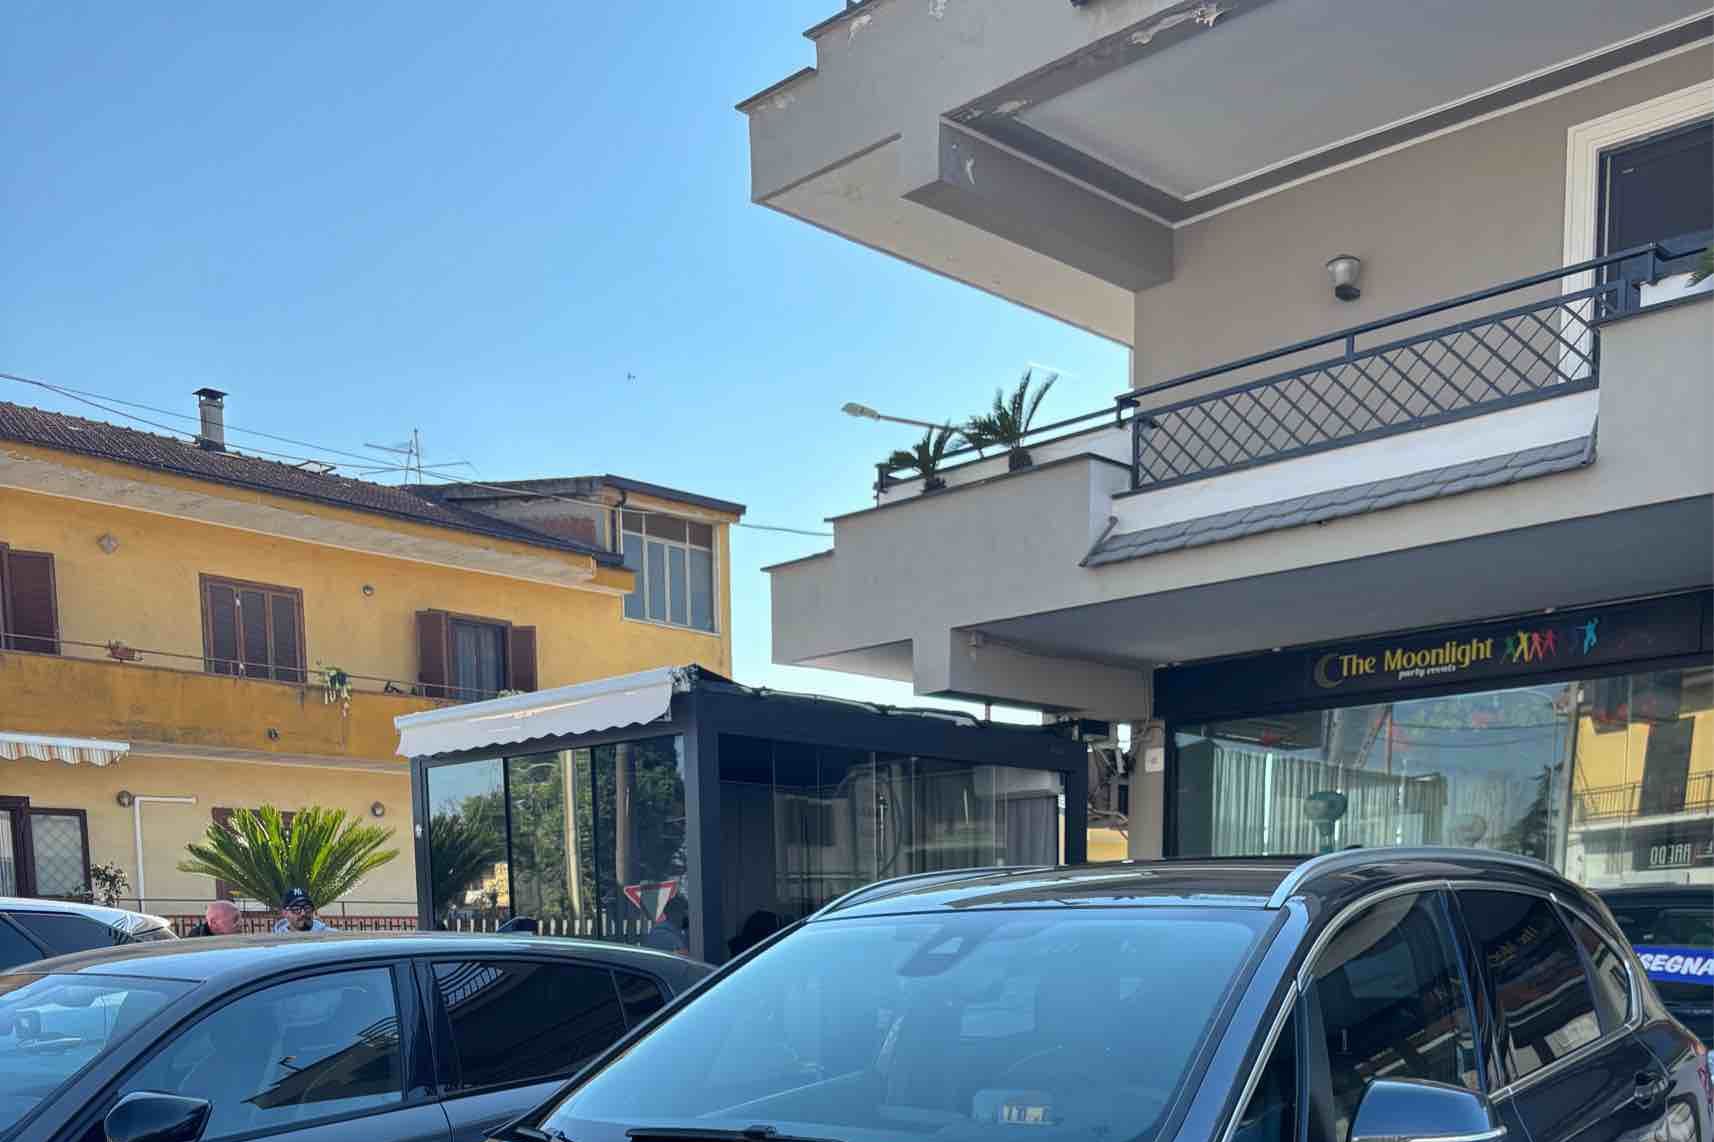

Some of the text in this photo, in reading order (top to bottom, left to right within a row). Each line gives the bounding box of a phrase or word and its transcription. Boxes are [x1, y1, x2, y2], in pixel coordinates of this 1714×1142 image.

[1339, 638, 1494, 678] The Moonlight
[1398, 667, 1425, 681] party
[1637, 952, 1714, 976] SEGNA
